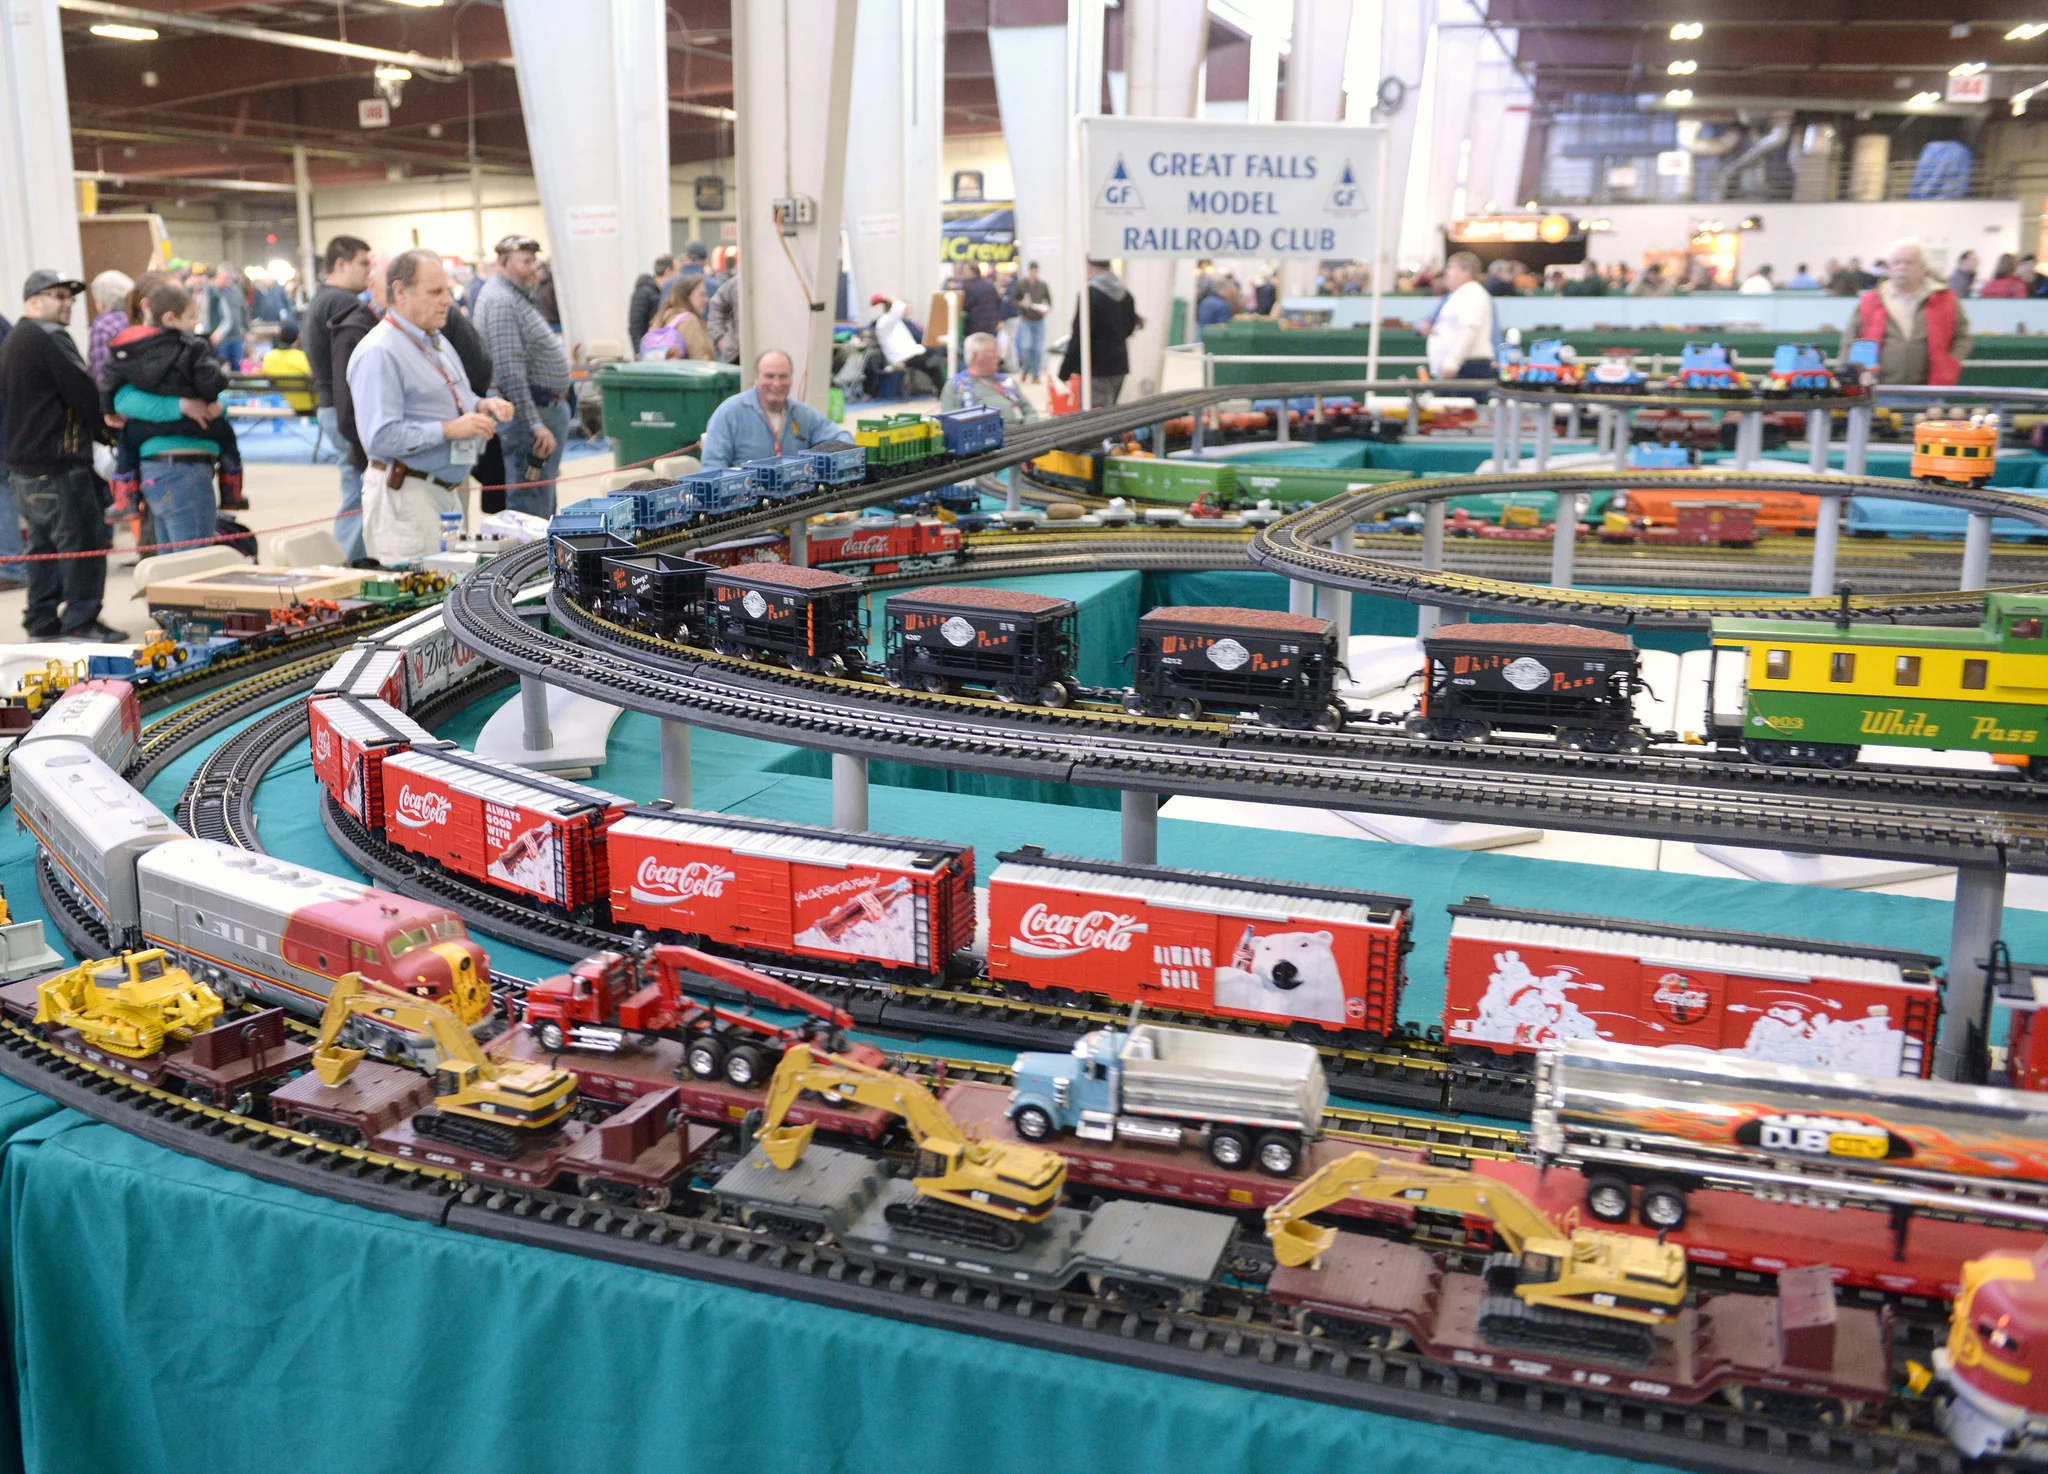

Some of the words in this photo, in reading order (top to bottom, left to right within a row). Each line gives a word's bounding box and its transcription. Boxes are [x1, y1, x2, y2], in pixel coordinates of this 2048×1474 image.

[1150, 152, 1234, 177] GREAT
[1246, 154, 1317, 179] FALLS
[1106, 186, 1132, 204] GF
[1187, 191, 1279, 214] MODEL
[1333, 190, 1356, 206] GF
[1123, 227, 1261, 251] RAILROAD
[1270, 228, 1336, 251] CLUB
[841, 535, 888, 556] Coca-Cola
[717, 585, 748, 602] White
[767, 603, 790, 620] Pass
[904, 613, 947, 631] White
[976, 630, 1008, 648] Pass
[1161, 635, 1214, 654] White
[424, 639, 456, 679] Diet
[1250, 653, 1290, 672] Pass
[1453, 655, 1511, 674] White
[1552, 671, 1595, 692] Pass
[1860, 708, 1940, 738] White
[1969, 715, 2040, 744] Pass
[396, 784, 452, 826] Coca-Cola
[485, 803, 521, 823] ALWAYS
[486, 815, 513, 831] GOOD
[486, 824, 511, 841] WITH
[487, 837, 504, 849] ICE.
[637, 856, 735, 899] Coca-Cola
[1020, 903, 1148, 952] Coca-Cola
[232, 952, 278, 973] SANTA
[1153, 945, 1212, 968] ALWAYS
[1160, 968, 1200, 990] COOL
[1760, 1125, 1829, 1154] DUB
